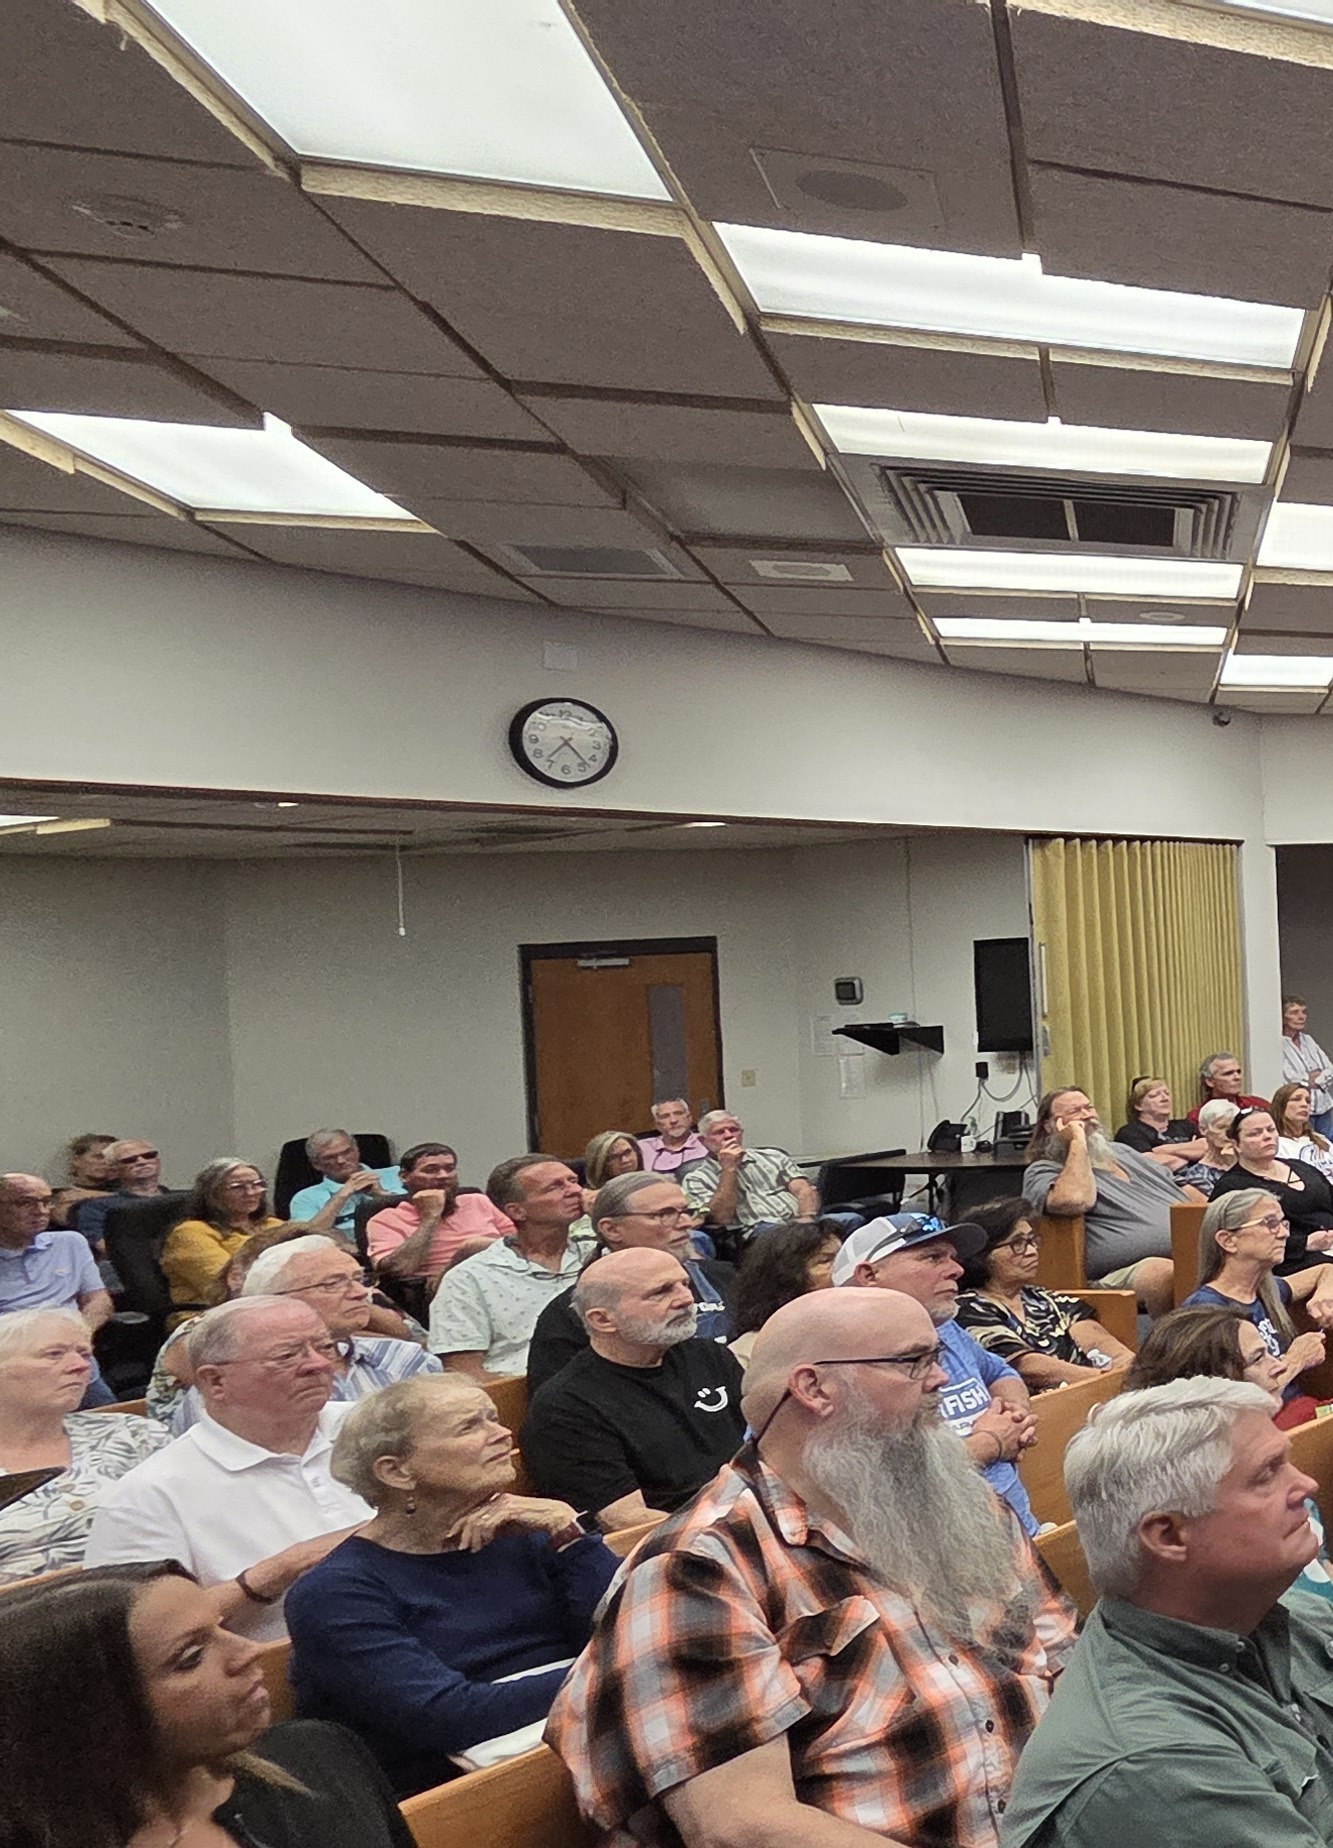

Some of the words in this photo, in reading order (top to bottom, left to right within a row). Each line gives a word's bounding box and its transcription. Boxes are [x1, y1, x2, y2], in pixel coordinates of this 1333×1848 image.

[528, 733, 539, 744] 9
[592, 740, 602, 751] 3
[532, 748, 544, 759] 8
[560, 764, 571, 775] 6
